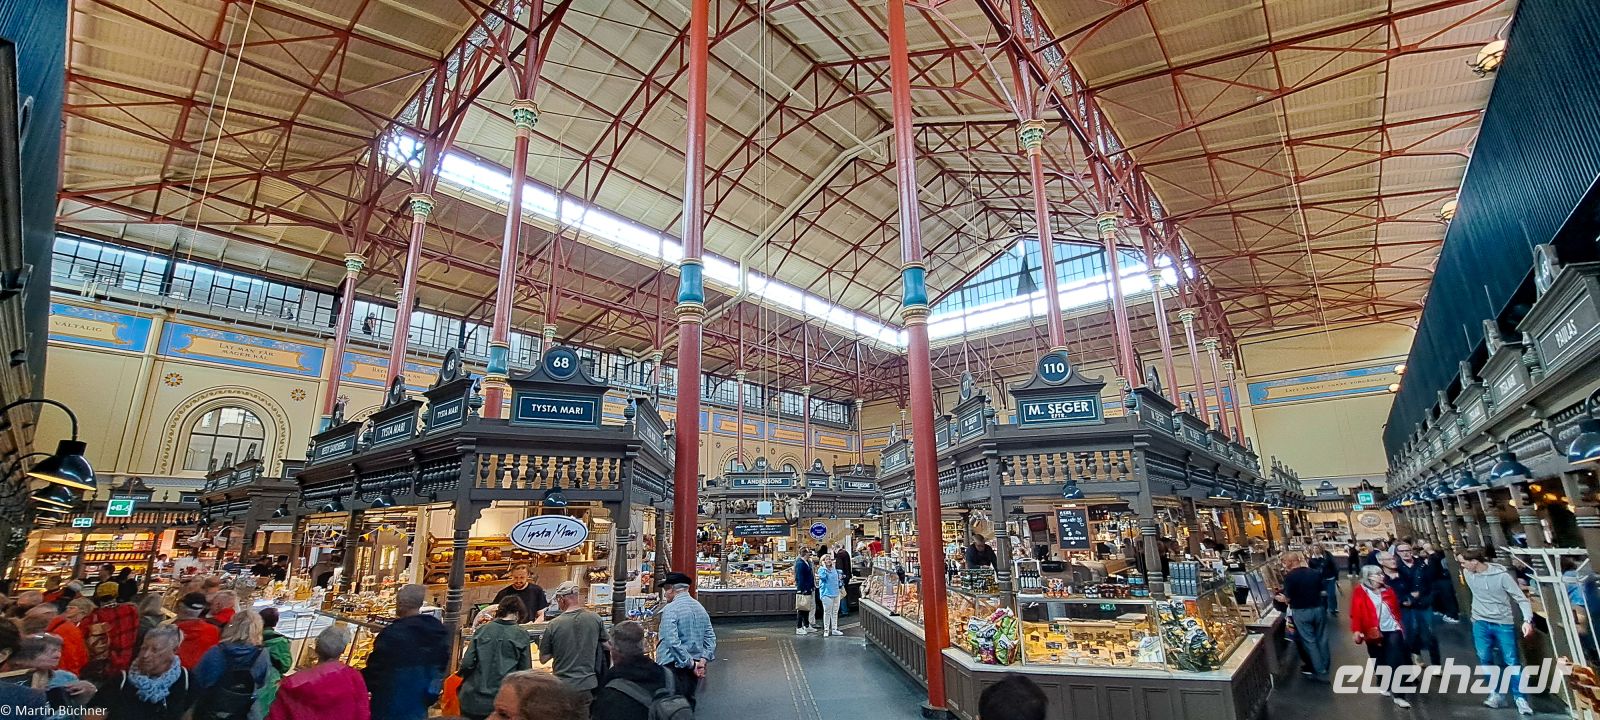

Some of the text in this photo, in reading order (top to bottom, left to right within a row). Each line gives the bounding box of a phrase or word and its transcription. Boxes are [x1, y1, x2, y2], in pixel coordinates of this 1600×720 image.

[1555, 319, 1578, 348] PAULAS
[553, 357, 569, 369] 68
[1043, 362, 1065, 374] 110
[437, 406, 459, 419] TYSTA MARI
[532, 404, 584, 415] TYSTA MARI
[1028, 402, 1089, 416] M. SEGER
[381, 422, 406, 438] TYSTA MARI
[521, 522, 579, 544] Tysta Mari
